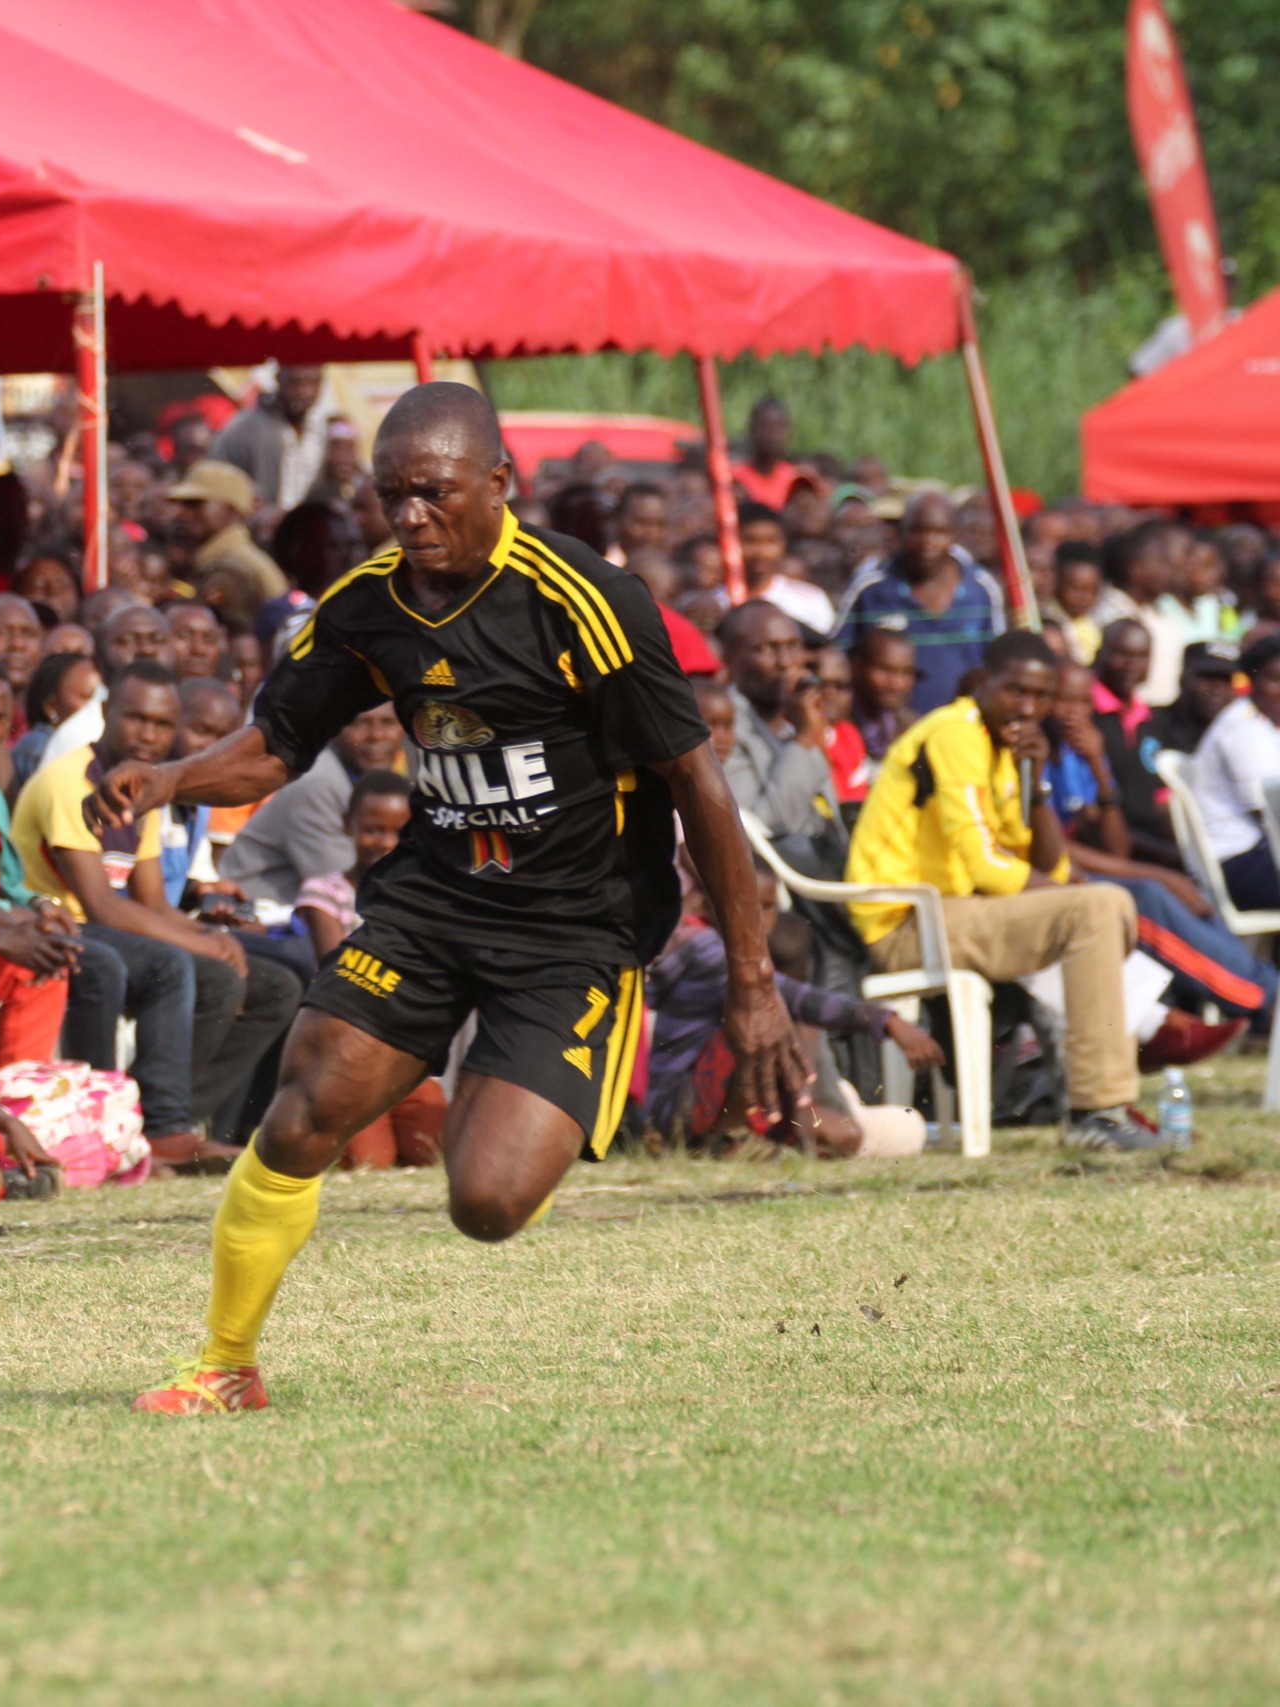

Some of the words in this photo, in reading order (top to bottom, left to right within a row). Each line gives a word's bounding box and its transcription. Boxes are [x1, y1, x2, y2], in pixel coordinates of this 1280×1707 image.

[417, 741, 555, 805] NILE
[432, 806, 536, 830] SPECIAL
[337, 947, 402, 993] NILE
[573, 986, 610, 1040] 7
